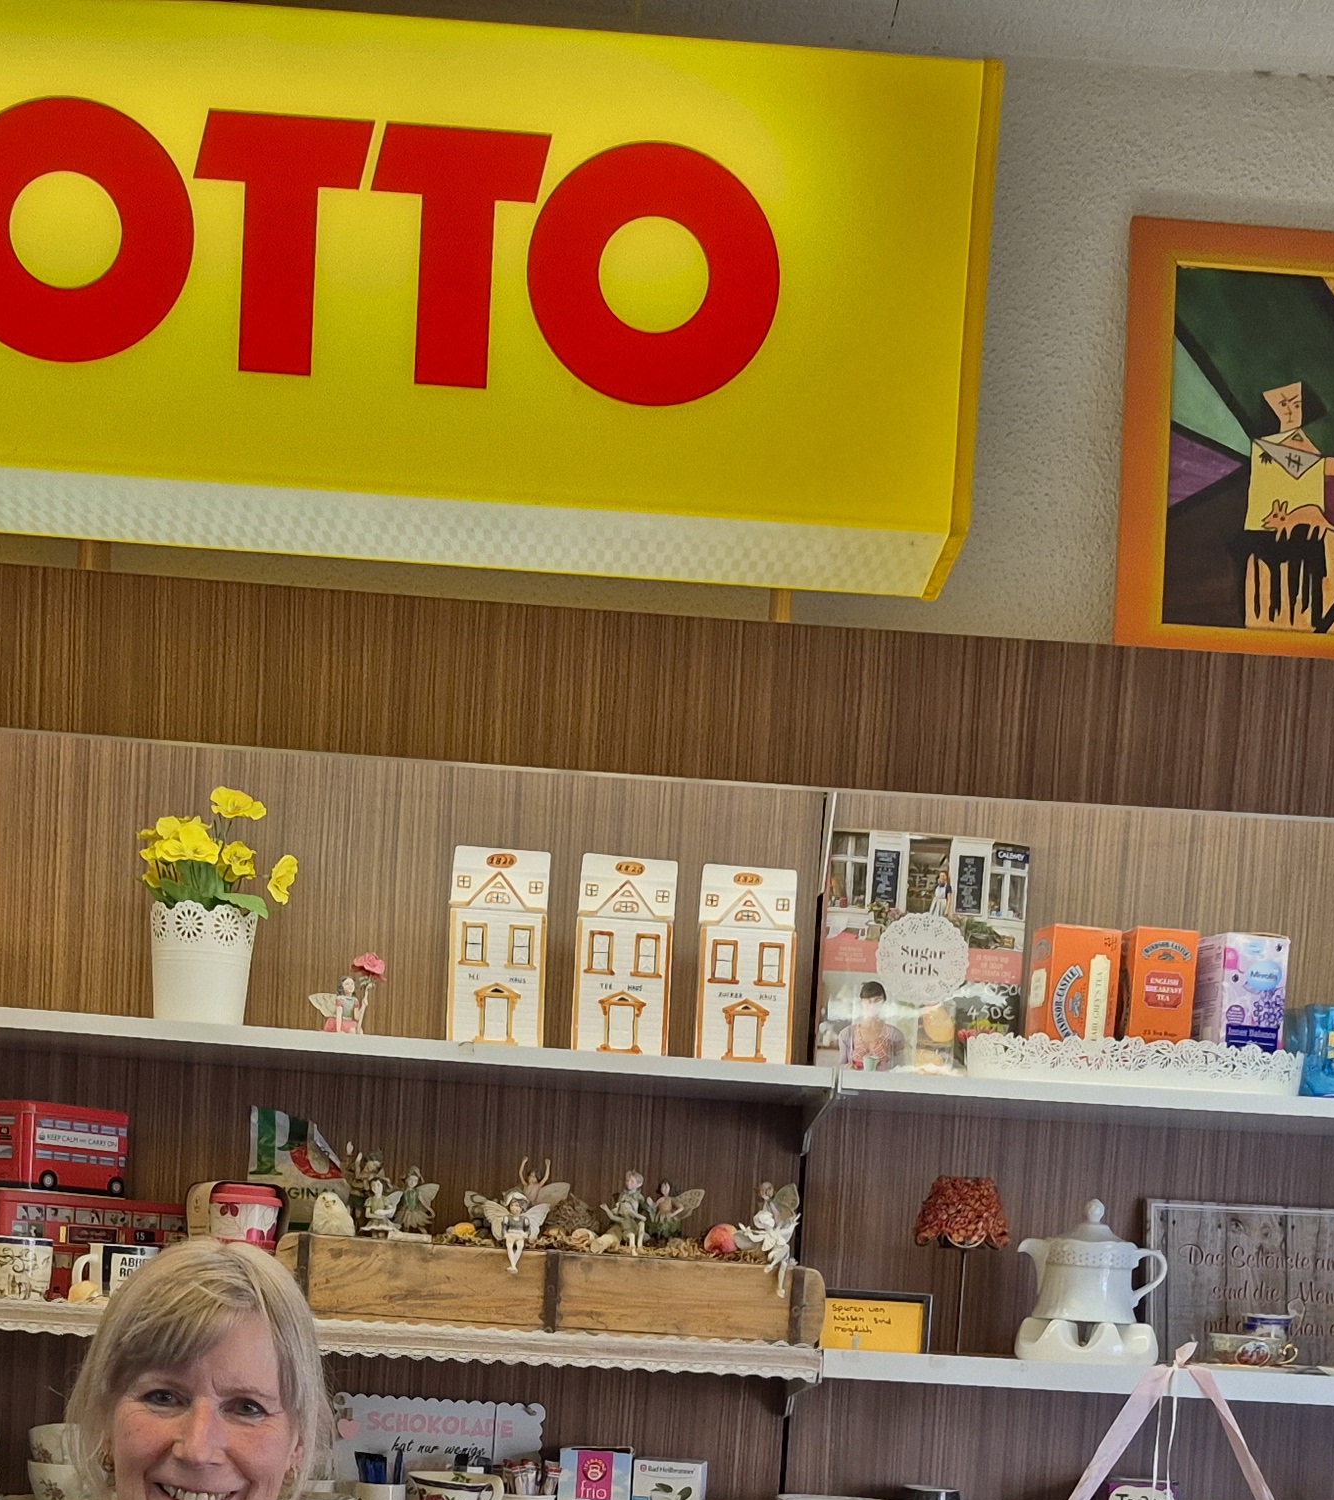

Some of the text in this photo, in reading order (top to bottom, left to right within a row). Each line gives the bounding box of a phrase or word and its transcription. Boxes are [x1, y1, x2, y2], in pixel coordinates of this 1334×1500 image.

[900, 944, 946, 961] Sugar
[902, 962, 940, 977] Girls
[1149, 977, 1179, 986] ENGLISH
[1145, 985, 1183, 994] BREAKFAST
[1156, 994, 1170, 1002] TEA
[62, 1135, 79, 1143] CALM
[88, 1138, 106, 1147] CARRY
[136, 1231, 145, 1240] 15
[1179, 1243, 1225, 1268] Das
[1230, 1245, 1311, 1271] Schönste
[1314, 1257, 1334, 1271] an
[1212, 1281, 1280, 1302] sind die
[832, 1304, 864, 1314] Spuren
[367, 1411, 514, 1438] SCHOKOLADE
[391, 1436, 440, 1453] hat nur
[580, 1480, 607, 1499] frio
